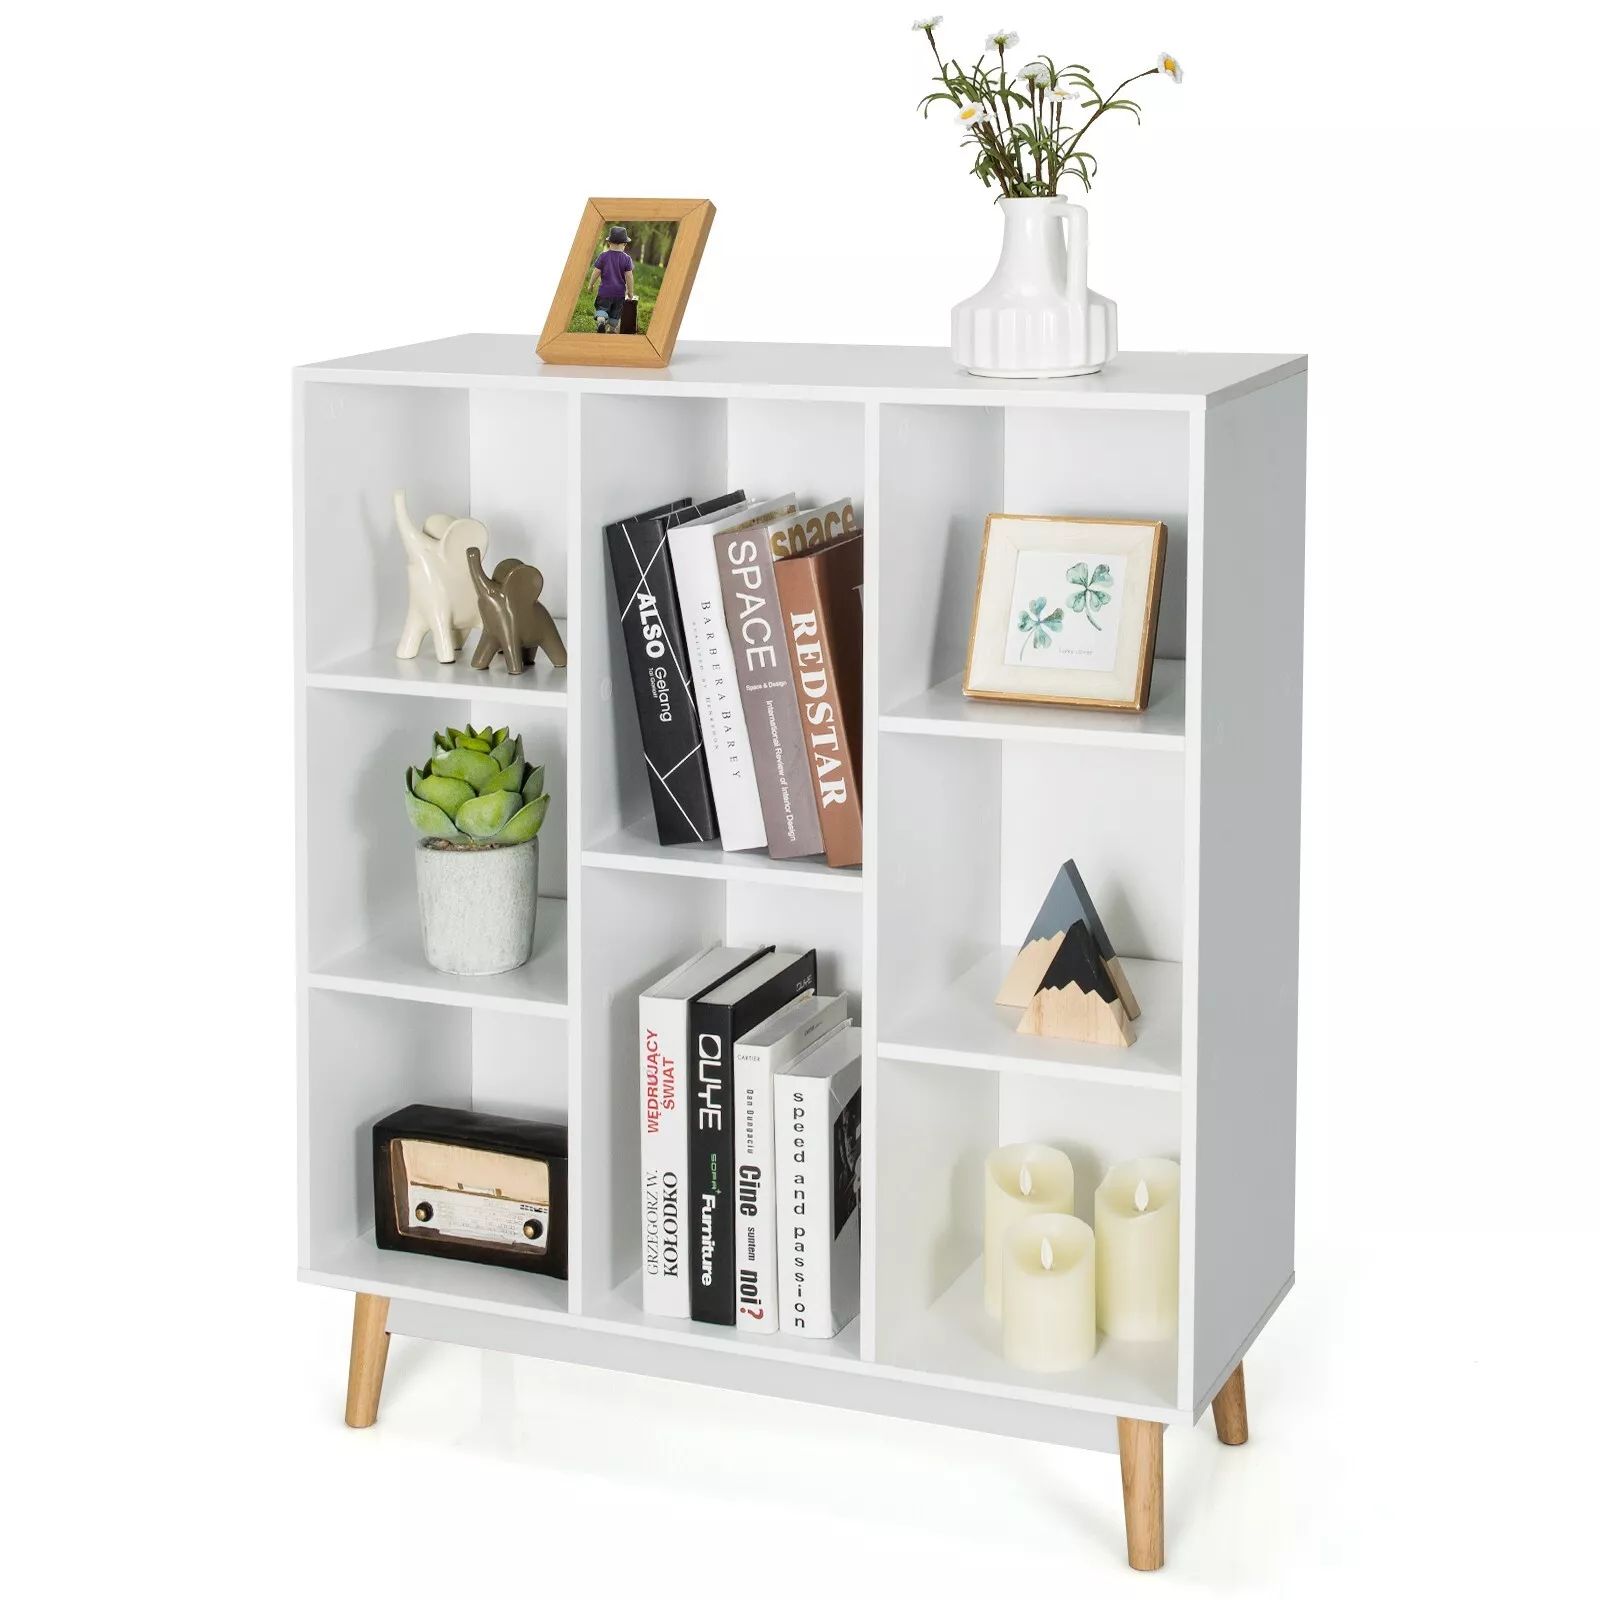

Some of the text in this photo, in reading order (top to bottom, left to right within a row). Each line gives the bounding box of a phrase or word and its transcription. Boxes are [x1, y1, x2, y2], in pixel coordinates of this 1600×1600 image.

[637, 592, 672, 722] ALSO Gelang
[727, 540, 777, 672] SPACE
[790, 609, 848, 809] REDSTAR
[766, 700, 796, 842] International Review of Interior Design
[647, 1028, 662, 1133] WĘDRUJĄCY
[660, 1056, 675, 1111] ŚWIAT
[746, 1089, 754, 1106] Dan
[646, 1169, 659, 1275] GRZEGORZ W.
[662, 1171, 679, 1278] KOŁODKO
[701, 1193, 716, 1286] Furniture
[738, 1165, 764, 1320] Cine suntem noi?
[793, 1092, 806, 1328] speed and passion
